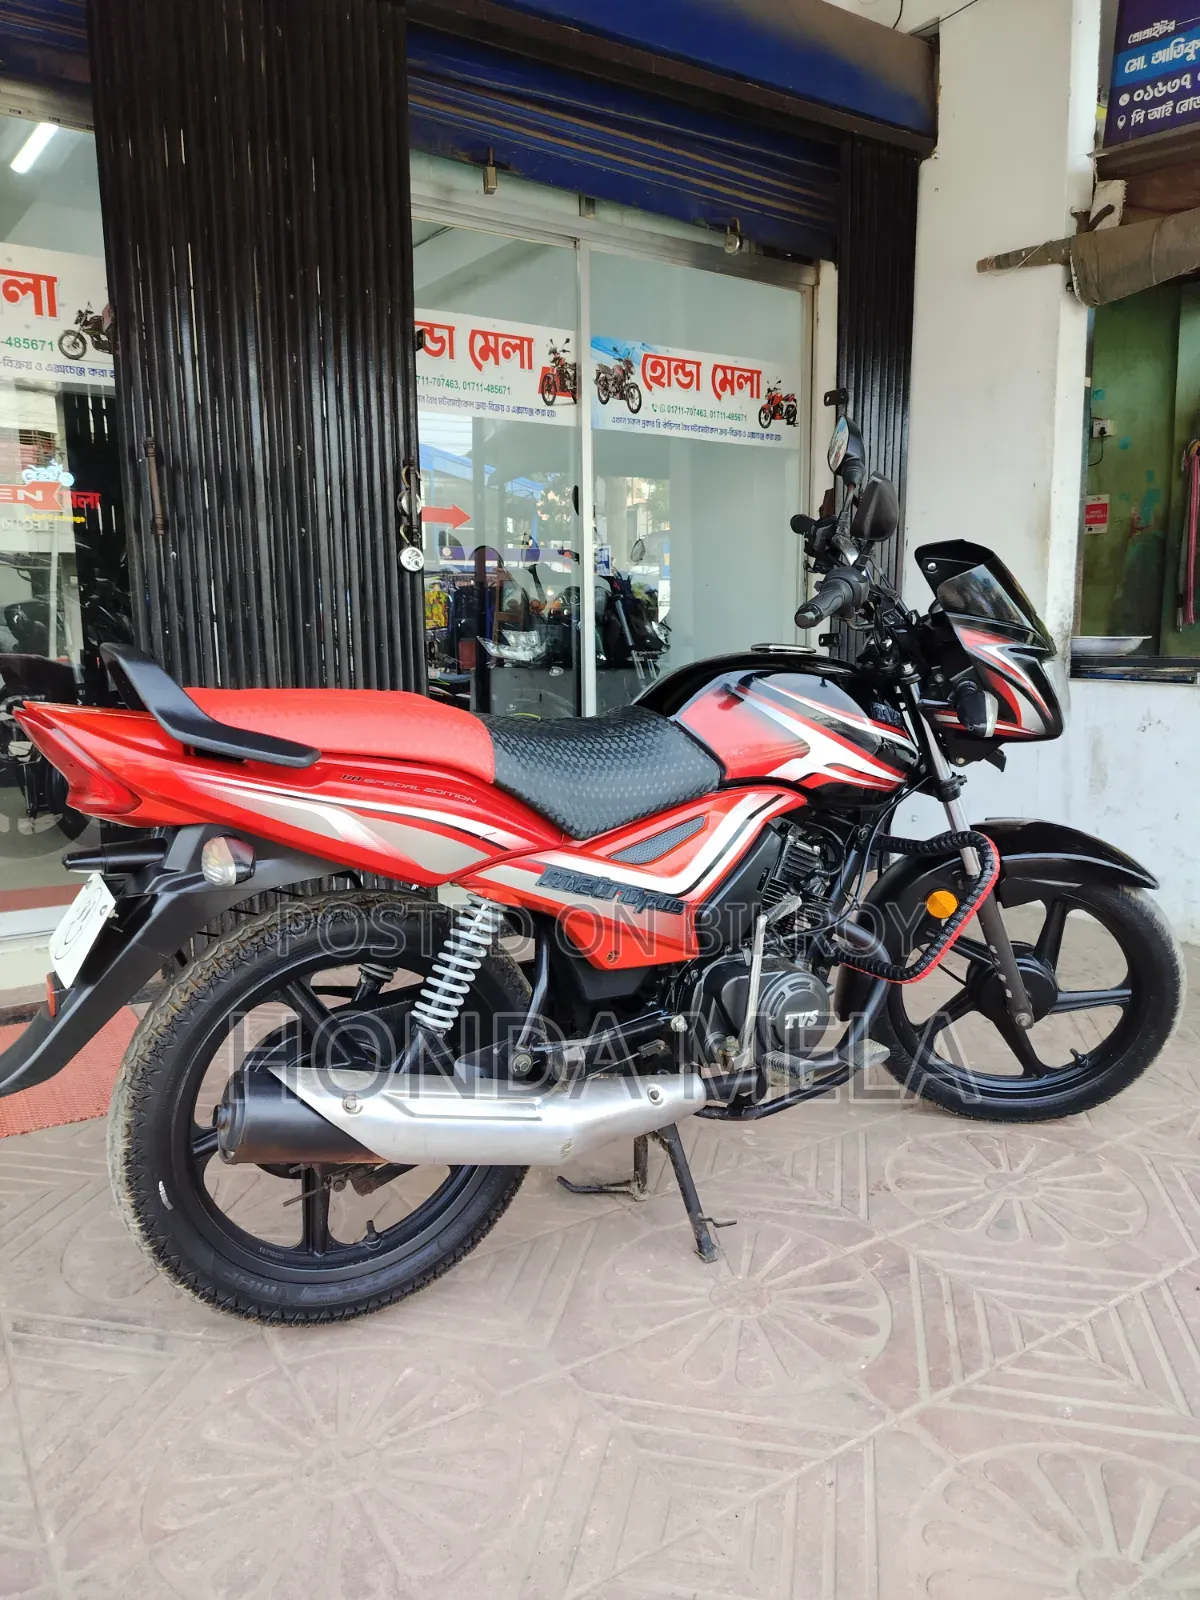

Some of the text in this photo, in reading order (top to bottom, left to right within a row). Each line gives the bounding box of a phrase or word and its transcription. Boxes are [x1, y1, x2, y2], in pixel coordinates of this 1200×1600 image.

[1124, 55, 1148, 74] মো.
[1131, 108, 1146, 126] পি
[1147, 100, 1174, 120] আই
[469, 329, 535, 372] মেলা
[462, 381, 511, 395] 01711-485671
[641, 353, 762, 401] হোন্ডা মেলা
[709, 411, 747, 422] 01711-485671
[364, 778, 420, 791] SPECIAL
[424, 787, 477, 804] EDITION
[785, 1010, 819, 1029] TVS
